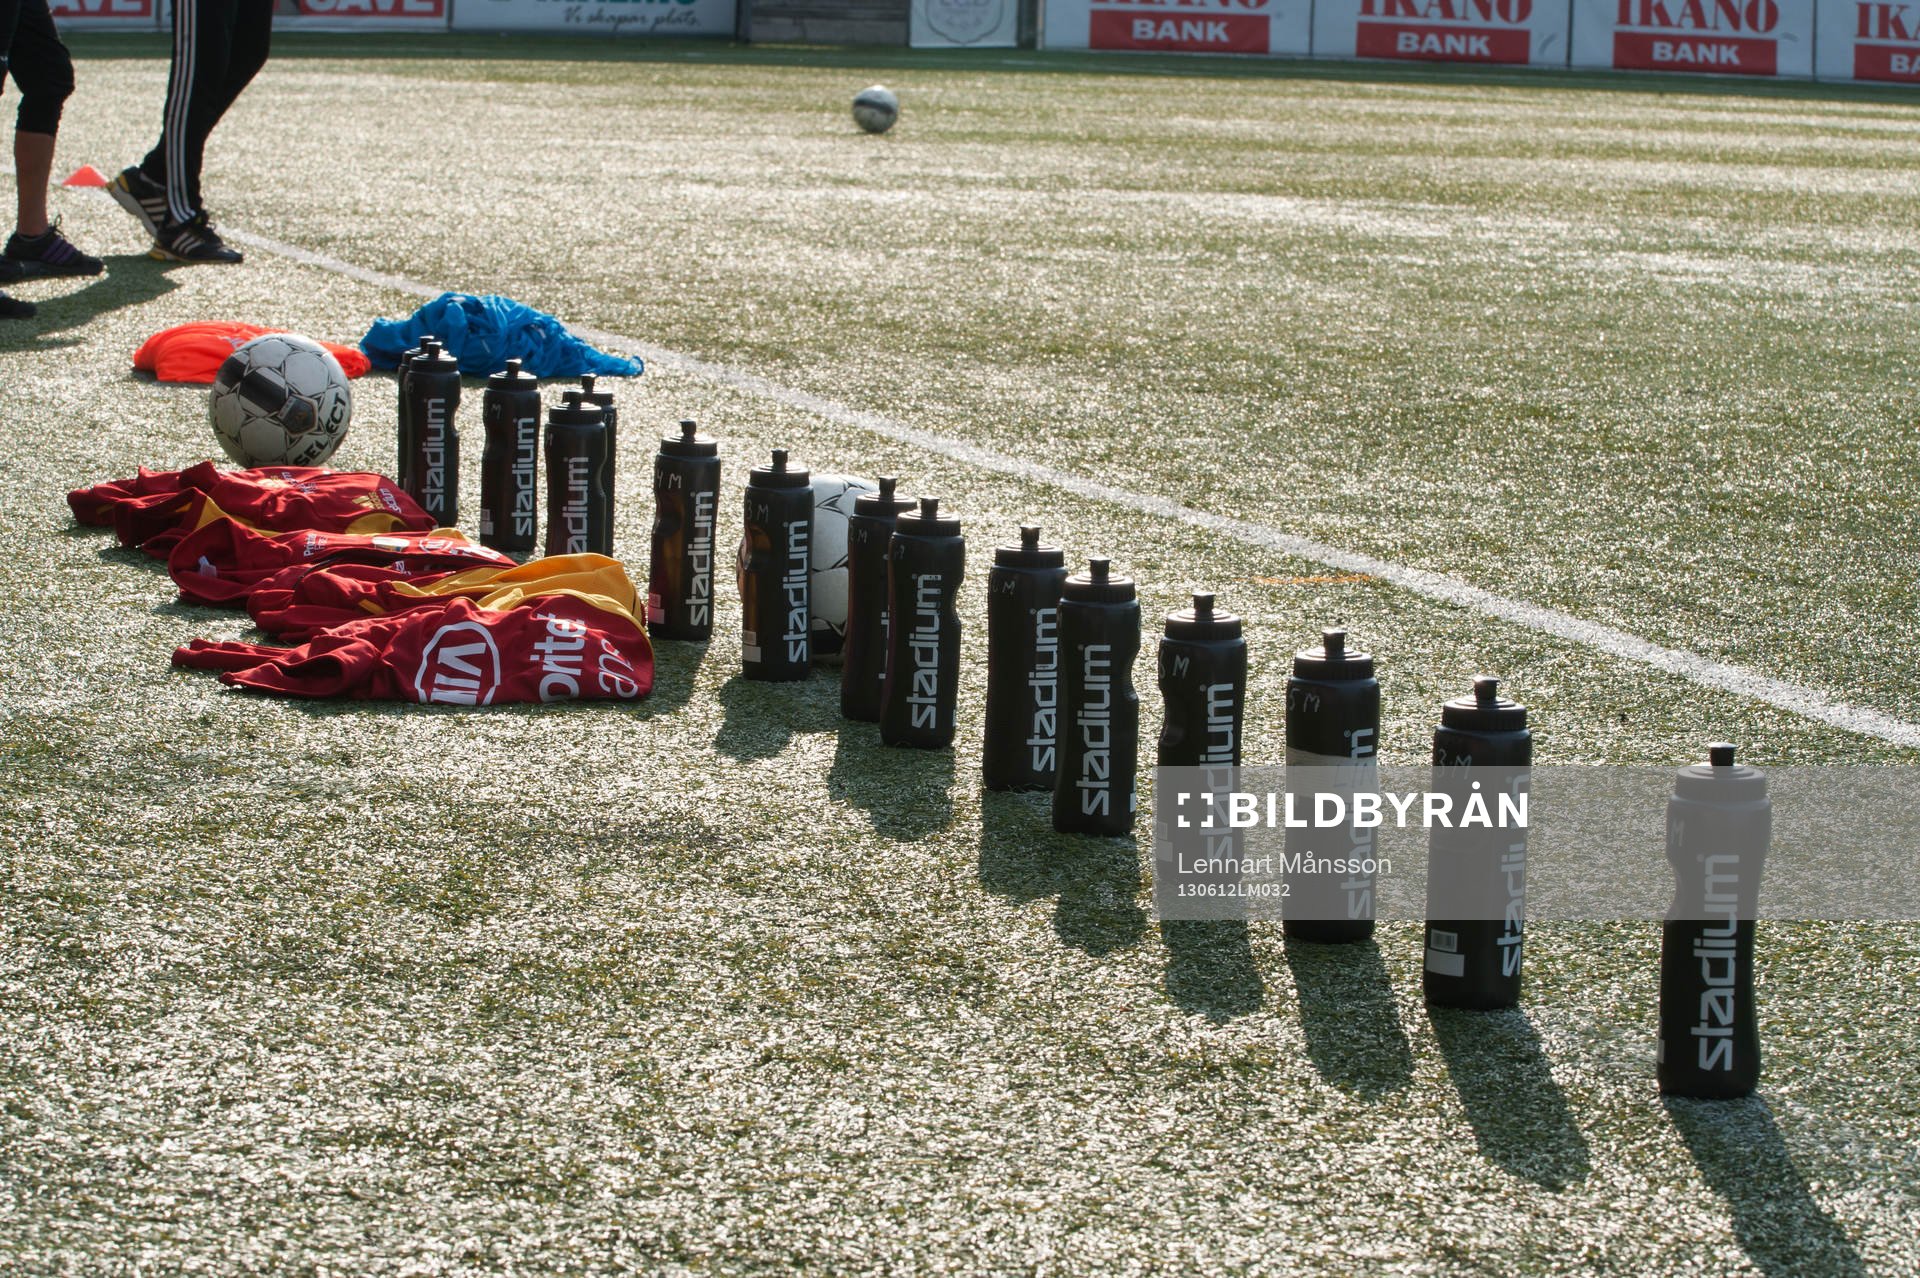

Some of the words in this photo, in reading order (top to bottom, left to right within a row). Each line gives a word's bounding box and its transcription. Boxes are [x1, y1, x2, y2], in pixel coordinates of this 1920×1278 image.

[1132, 18, 1230, 42] BANK
[1397, 31, 1491, 56] BANK
[1652, 41, 1741, 65] BANK
[1855, 2, 1920, 40] IK
[420, 398, 446, 512] stadium
[512, 417, 535, 536] stadium
[562, 456, 589, 554] adium
[686, 490, 714, 626] stadium
[783, 520, 809, 663] stadium
[906, 573, 942, 729] stadium
[1026, 607, 1058, 772] stadium
[1076, 644, 1111, 816] stadium
[1690, 855, 1740, 1071] stadium
